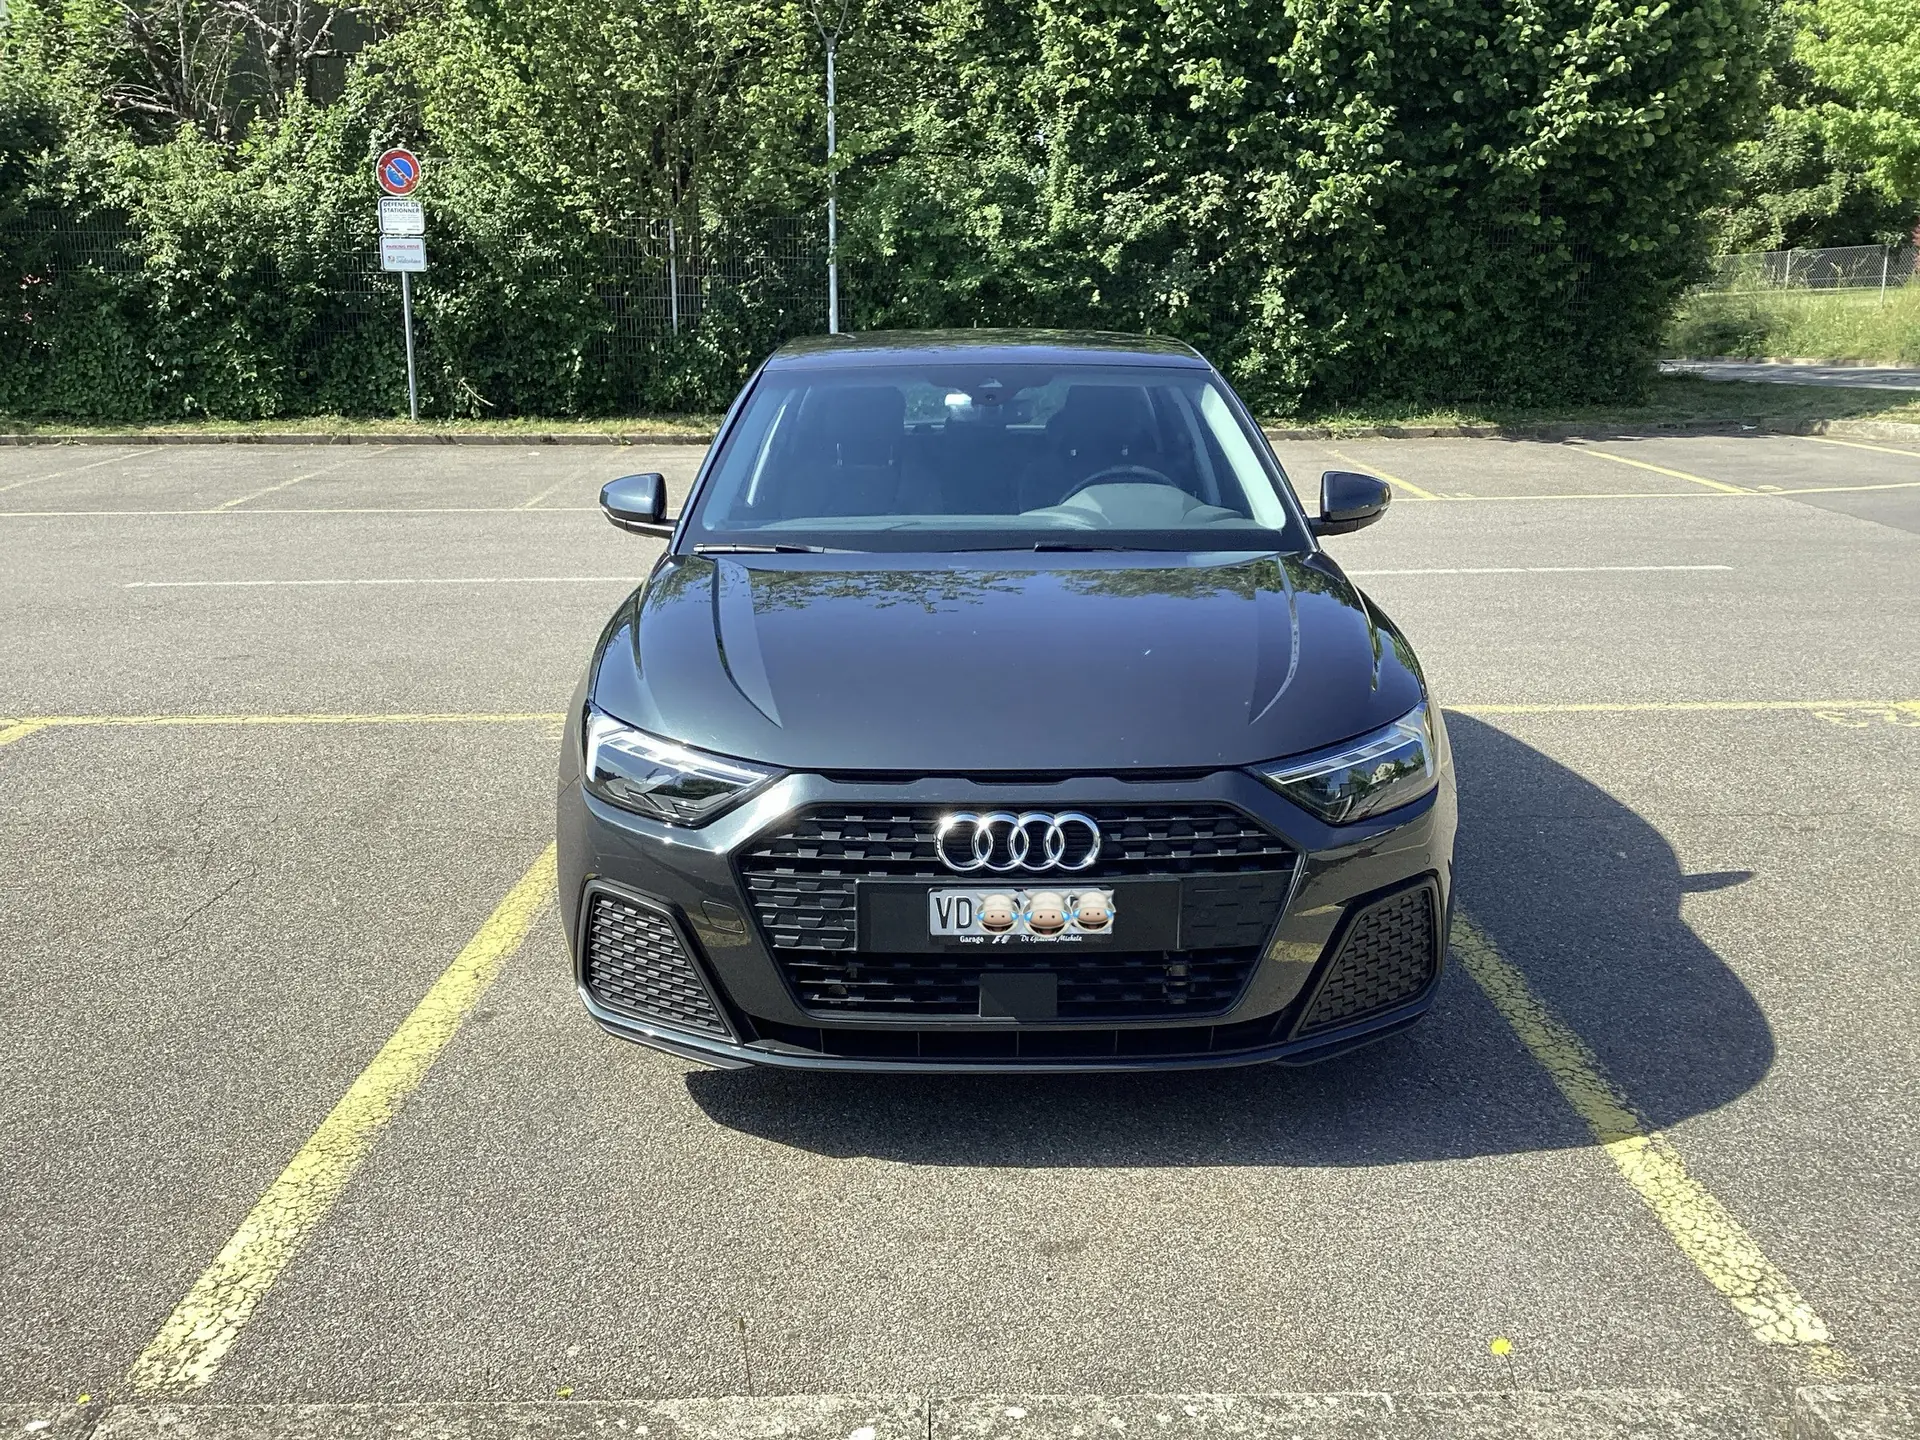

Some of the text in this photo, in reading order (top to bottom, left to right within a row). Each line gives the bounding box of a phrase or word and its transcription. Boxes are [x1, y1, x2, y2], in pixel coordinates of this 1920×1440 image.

[935, 896, 973, 929] VD
[959, 935, 984, 944] Garage
[1056, 934, 1082, 943] Michele
